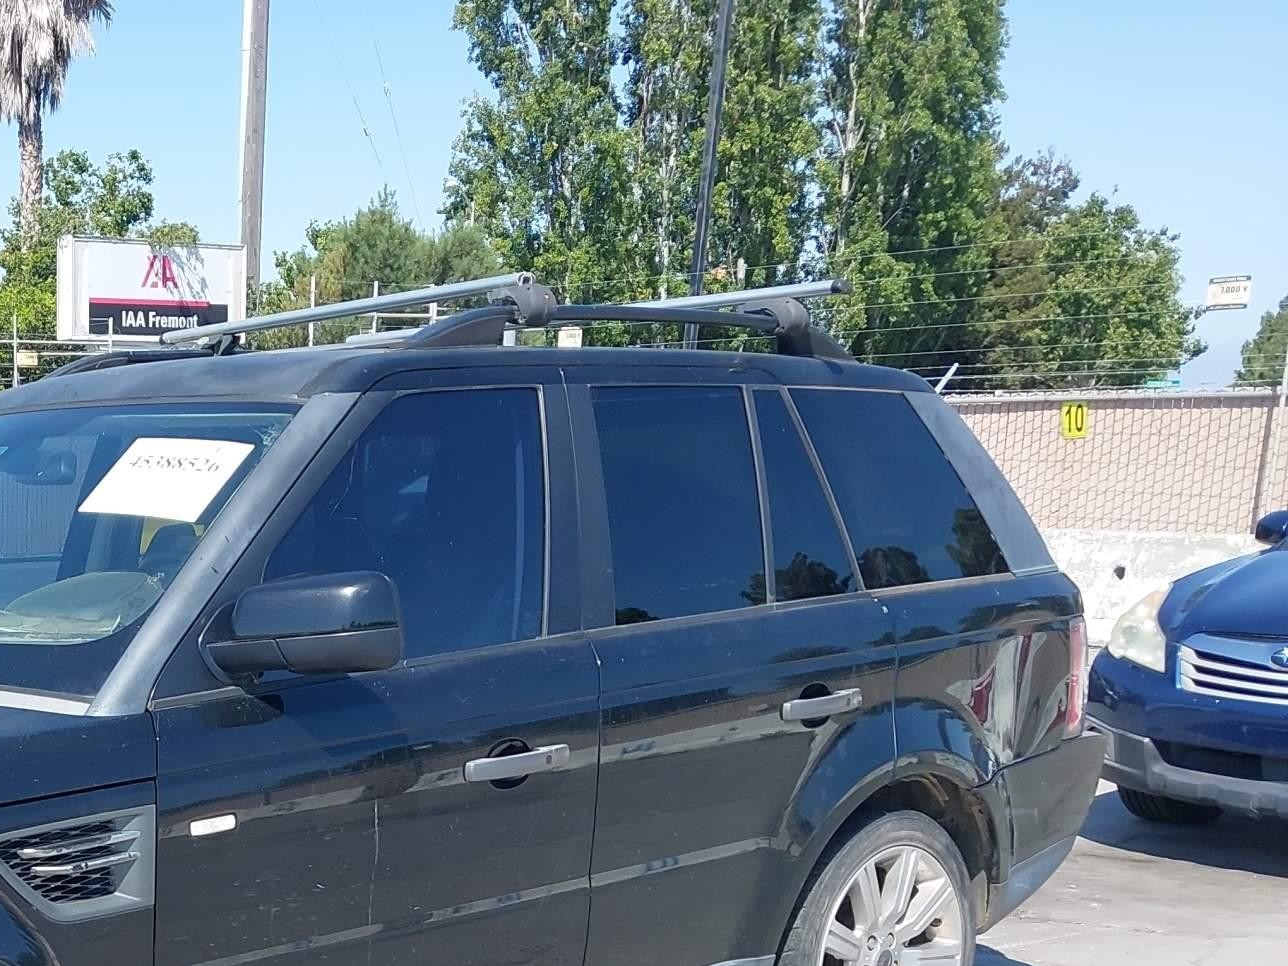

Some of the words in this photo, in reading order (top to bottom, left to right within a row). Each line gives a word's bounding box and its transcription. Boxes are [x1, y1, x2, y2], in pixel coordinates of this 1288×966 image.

[121, 310, 146, 328] IAA
[148, 311, 199, 329] Fremont
[1065, 404, 1084, 433] 10
